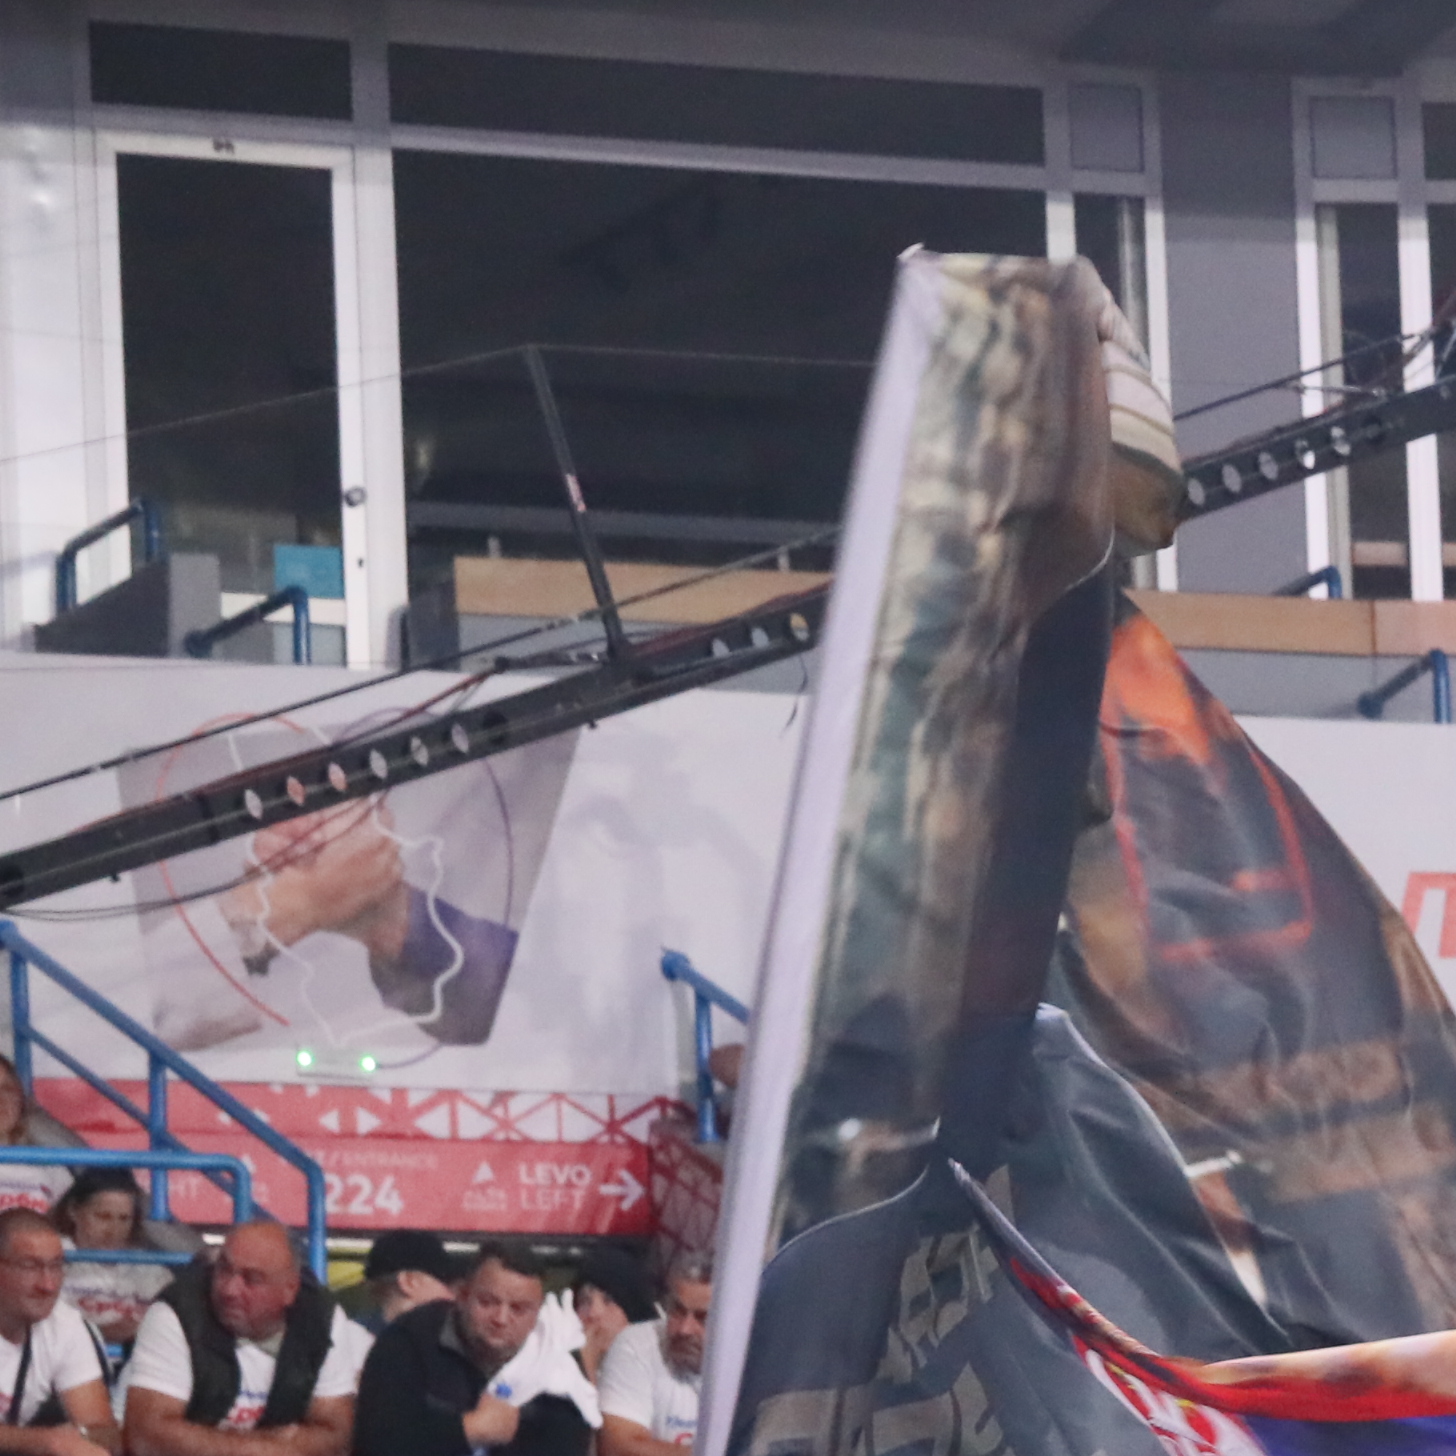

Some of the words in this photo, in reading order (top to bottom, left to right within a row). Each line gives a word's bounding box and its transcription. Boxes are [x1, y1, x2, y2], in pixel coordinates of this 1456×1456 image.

[519, 1163, 592, 1187] LEVO
[326, 1174, 404, 1216] 224
[519, 1189, 586, 1211] LEFT
